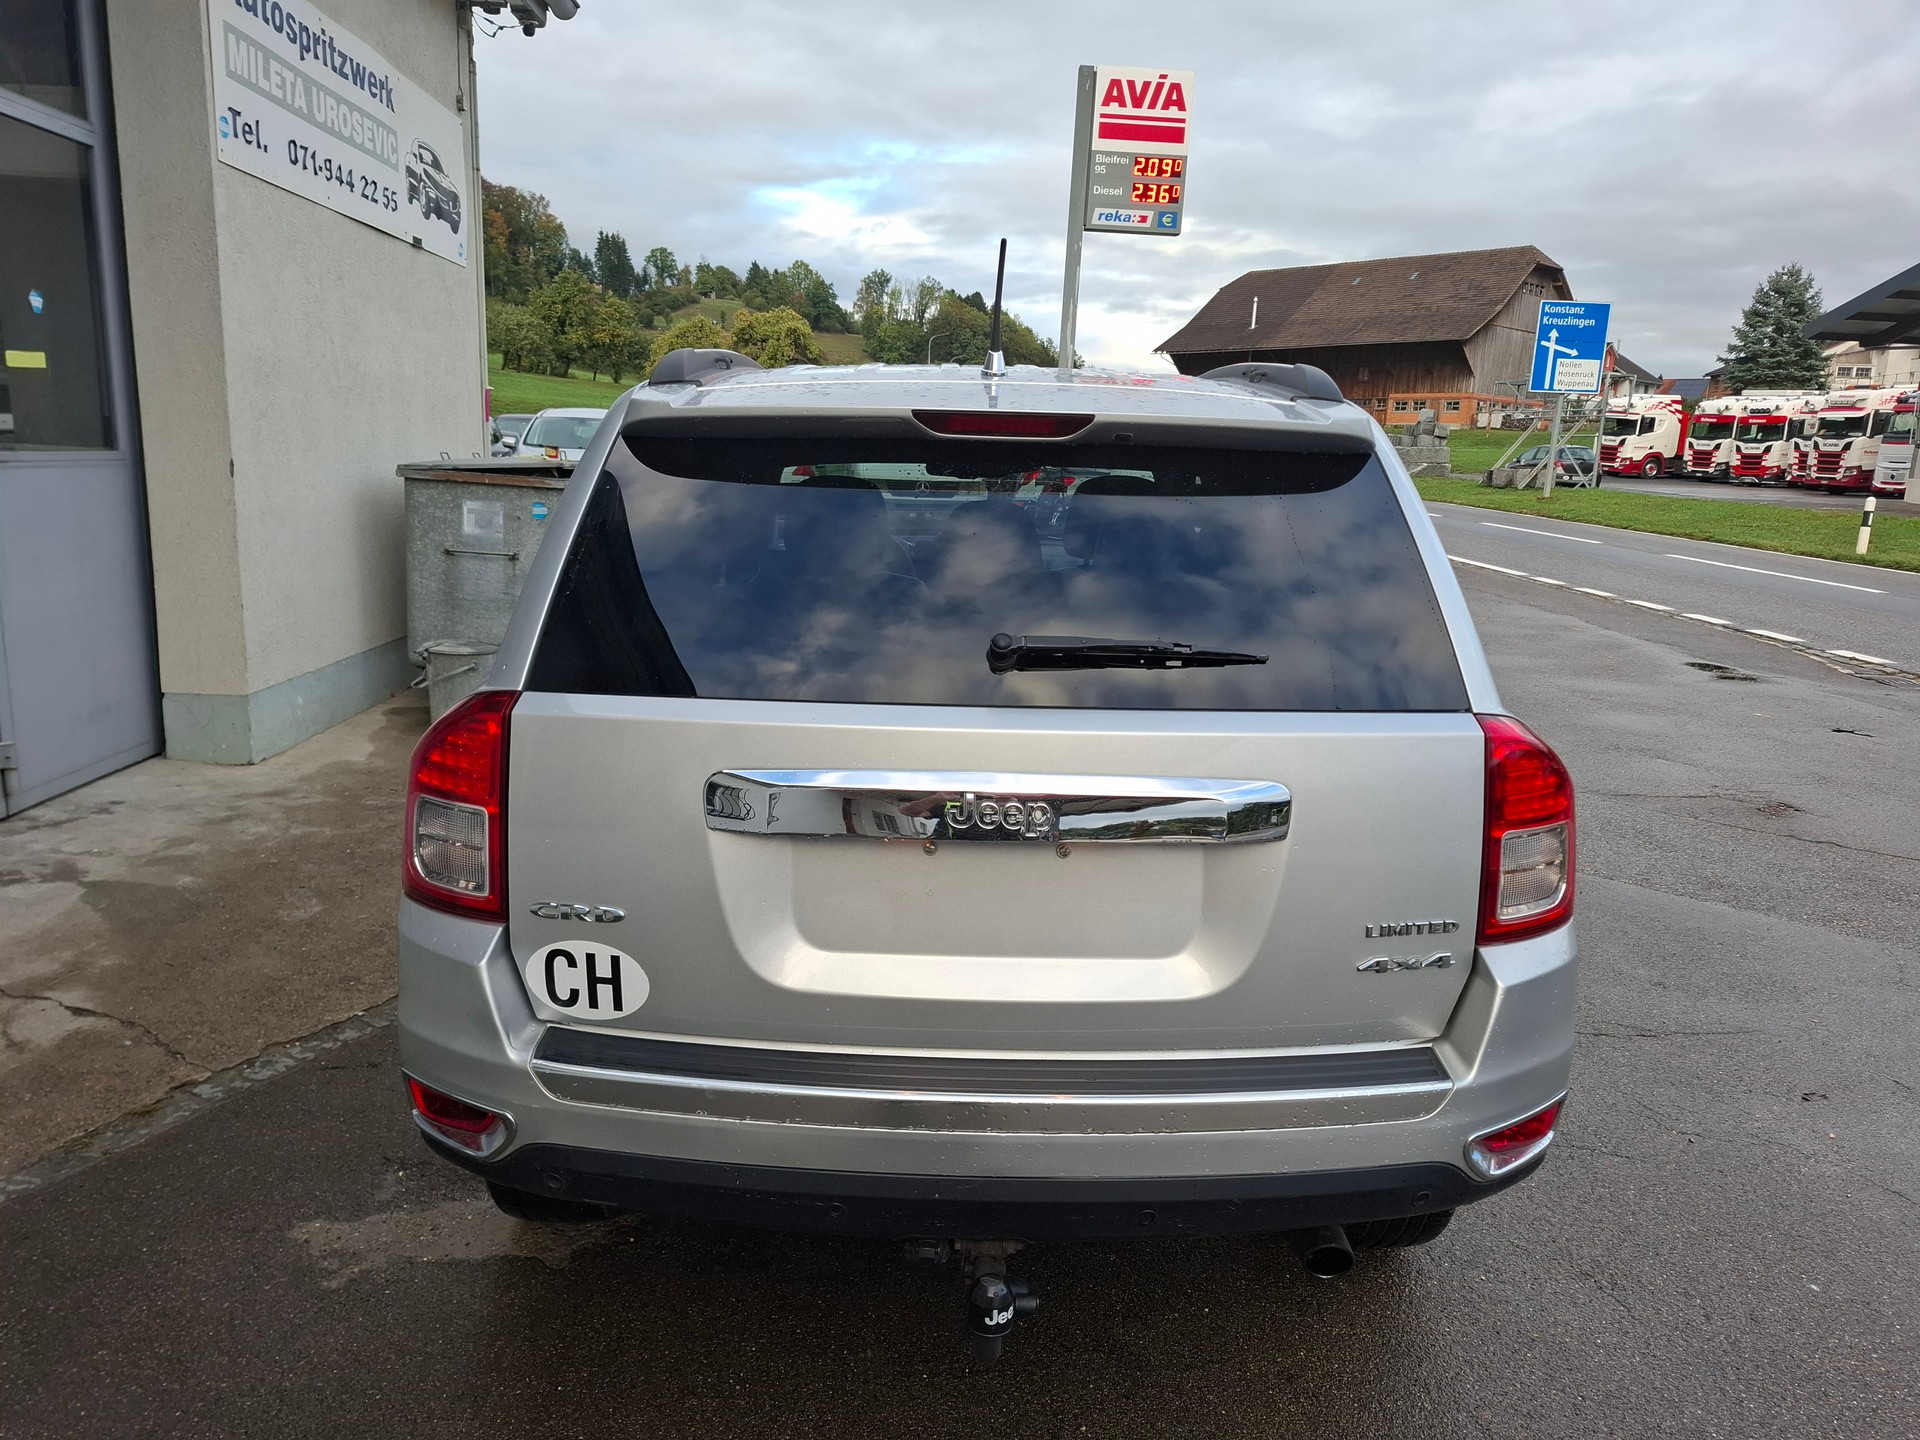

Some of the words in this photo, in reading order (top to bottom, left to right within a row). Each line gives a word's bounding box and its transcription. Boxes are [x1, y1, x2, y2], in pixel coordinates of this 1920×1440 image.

[235, 0, 395, 113] tospritzwerk
[227, 33, 307, 114] MILETA
[311, 86, 397, 164] UROSEVIC
[228, 107, 268, 153] Tel.
[360, 176, 378, 204] 22
[382, 187, 398, 212] 55
[1096, 154, 1129, 164] Bleifrei
[1094, 165, 1106, 174] 95
[1093, 185, 1123, 196] Diesel
[1544, 304, 1585, 314] Konstanz
[1542, 316, 1595, 328] Kreuzlingen
[1559, 361, 1582, 369] Nollen
[1557, 370, 1595, 378] Hosenruck
[1557, 379, 1594, 388] Wuppenau
[946, 791, 1053, 838] Jeep
[529, 902, 626, 923] CRD
[1365, 920, 1459, 938] LIMITED
[544, 948, 624, 1012] CH
[984, 1306, 1014, 1325] Jee
